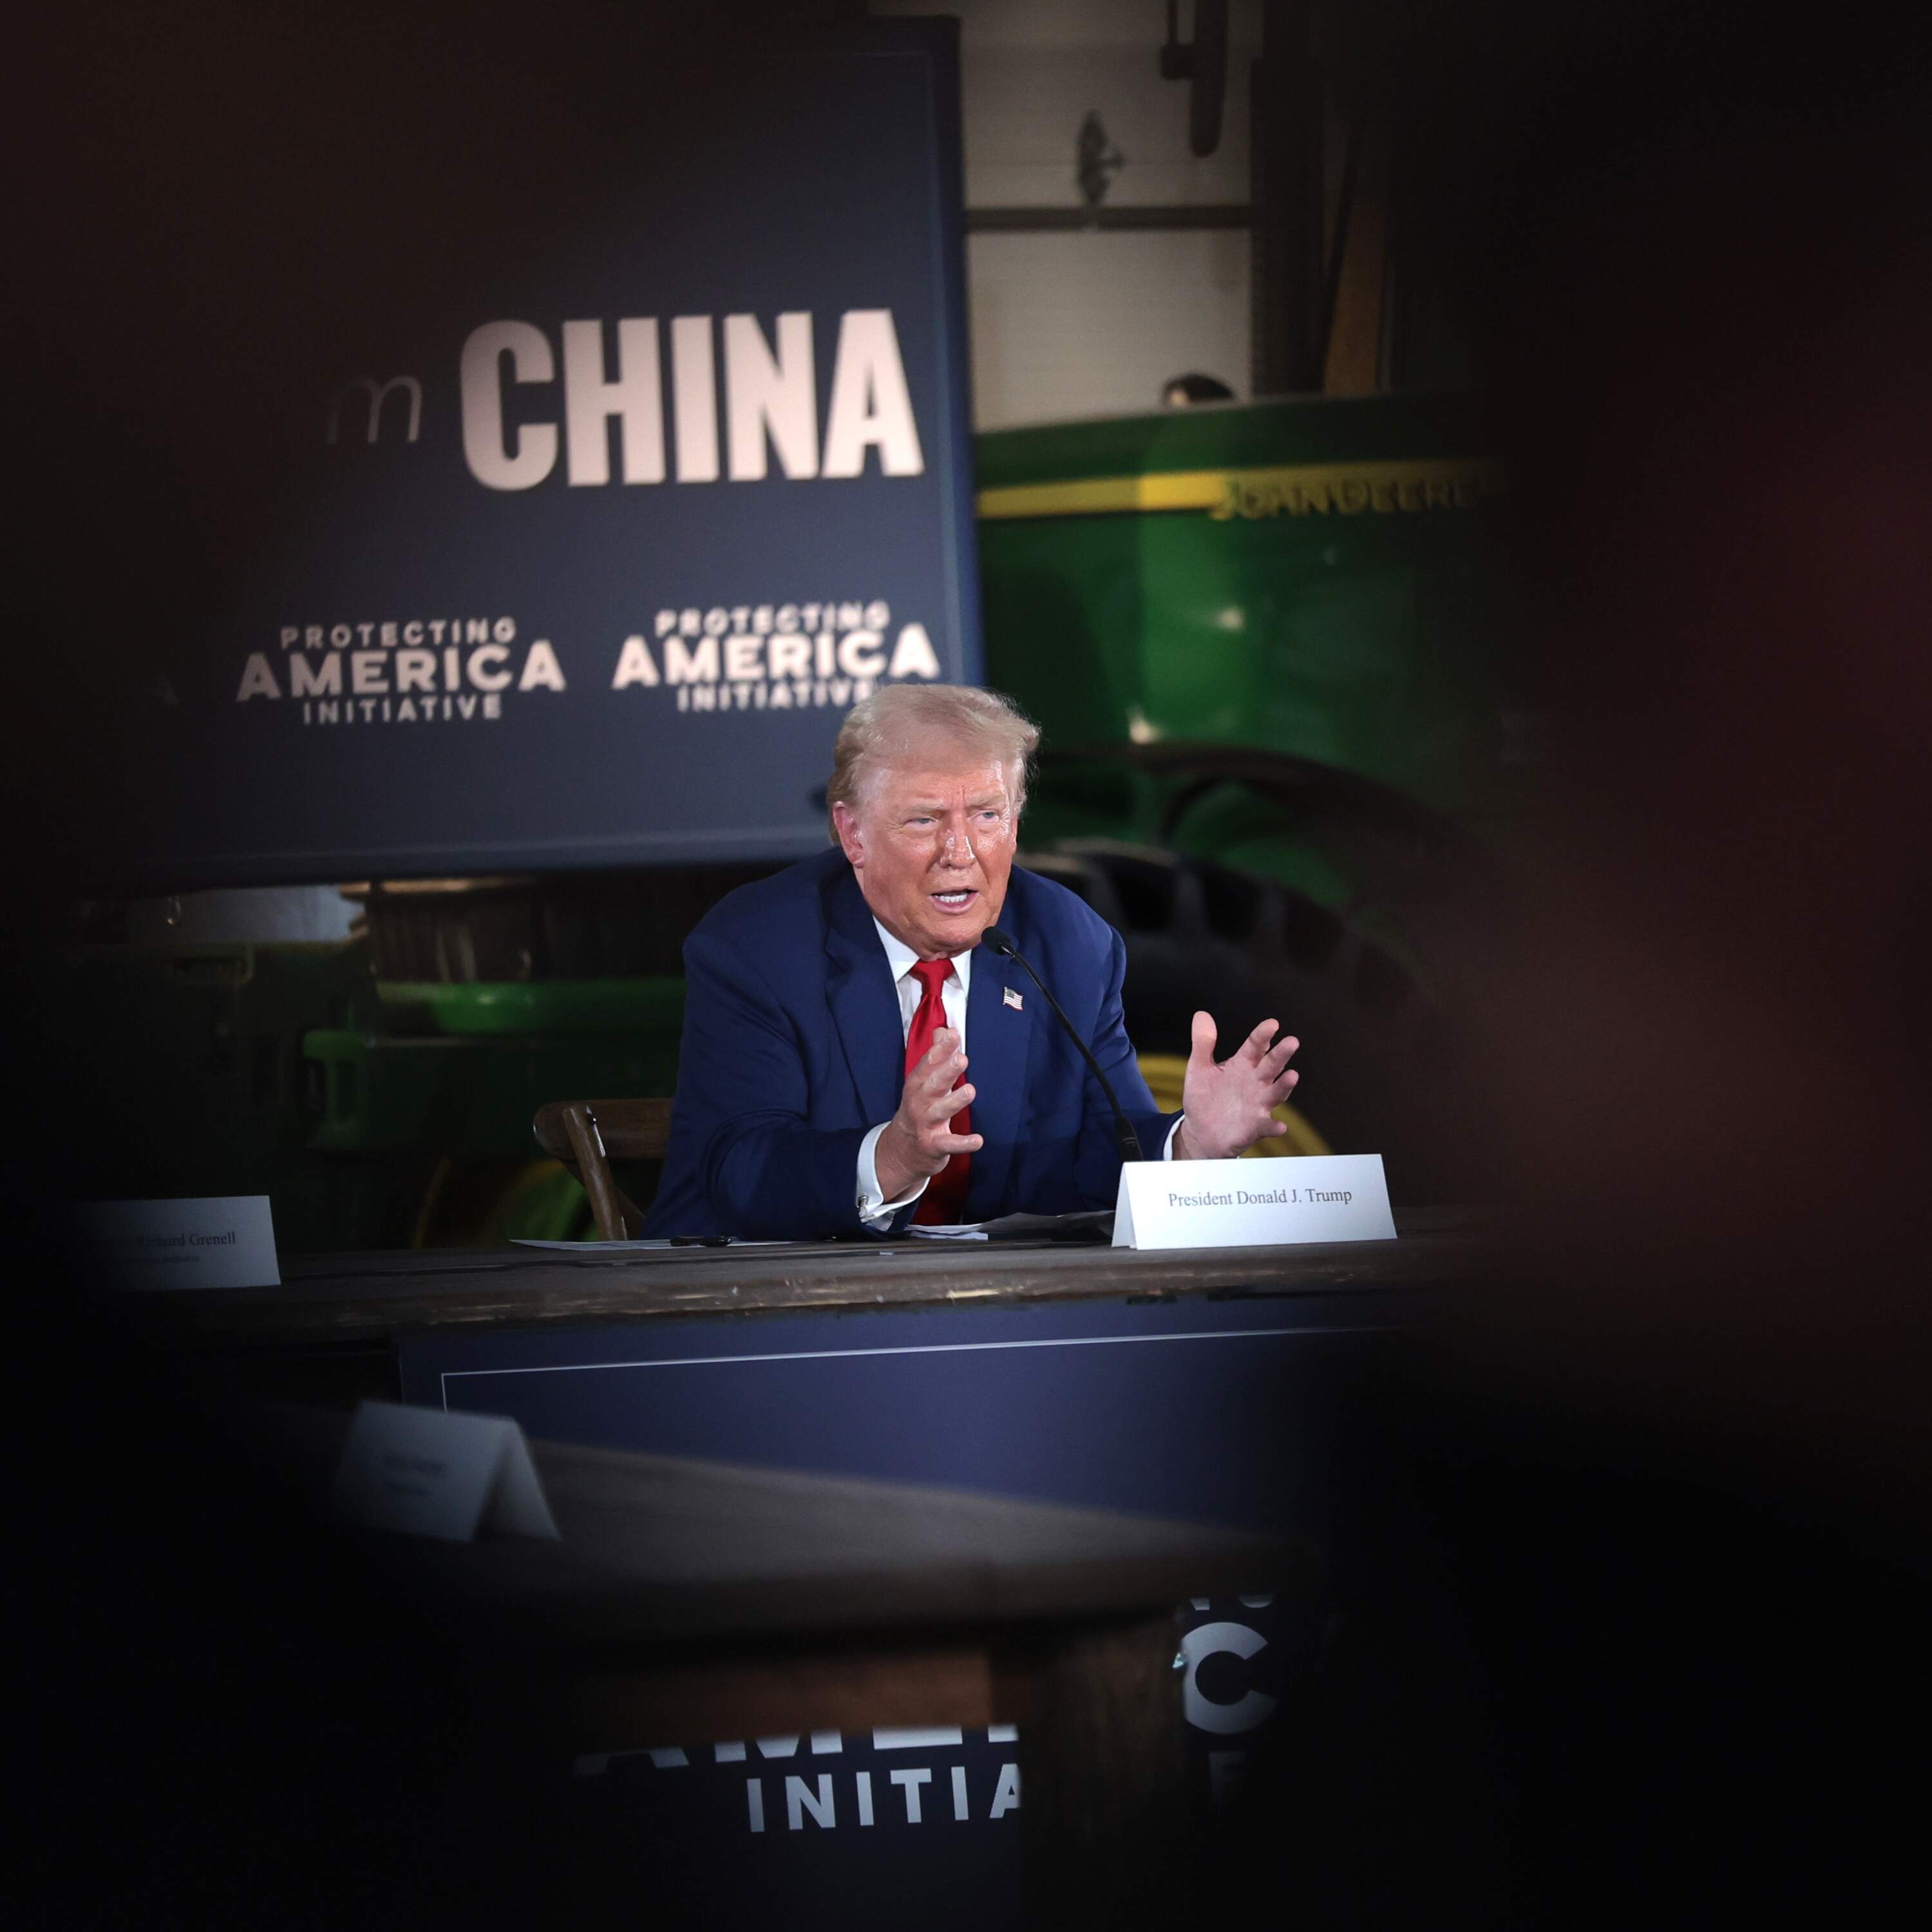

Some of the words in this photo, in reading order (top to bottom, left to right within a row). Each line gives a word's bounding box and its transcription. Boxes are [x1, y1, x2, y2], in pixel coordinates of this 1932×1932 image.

[460, 308, 925, 491] CHINA
[279, 616, 516, 649] PROTECTING
[654, 600, 891, 636] PROTECTING
[236, 640, 567, 702] AMERICA
[612, 623, 941, 688] AMERICA
[303, 694, 502, 725] INITIATIVE
[1168, 1191, 1233, 1207] President
[1236, 1189, 1287, 1205] Donald
[1291, 1189, 1302, 1204] J.
[1305, 1188, 1352, 1206] Trump
[189, 1232, 236, 1246] Grenell
